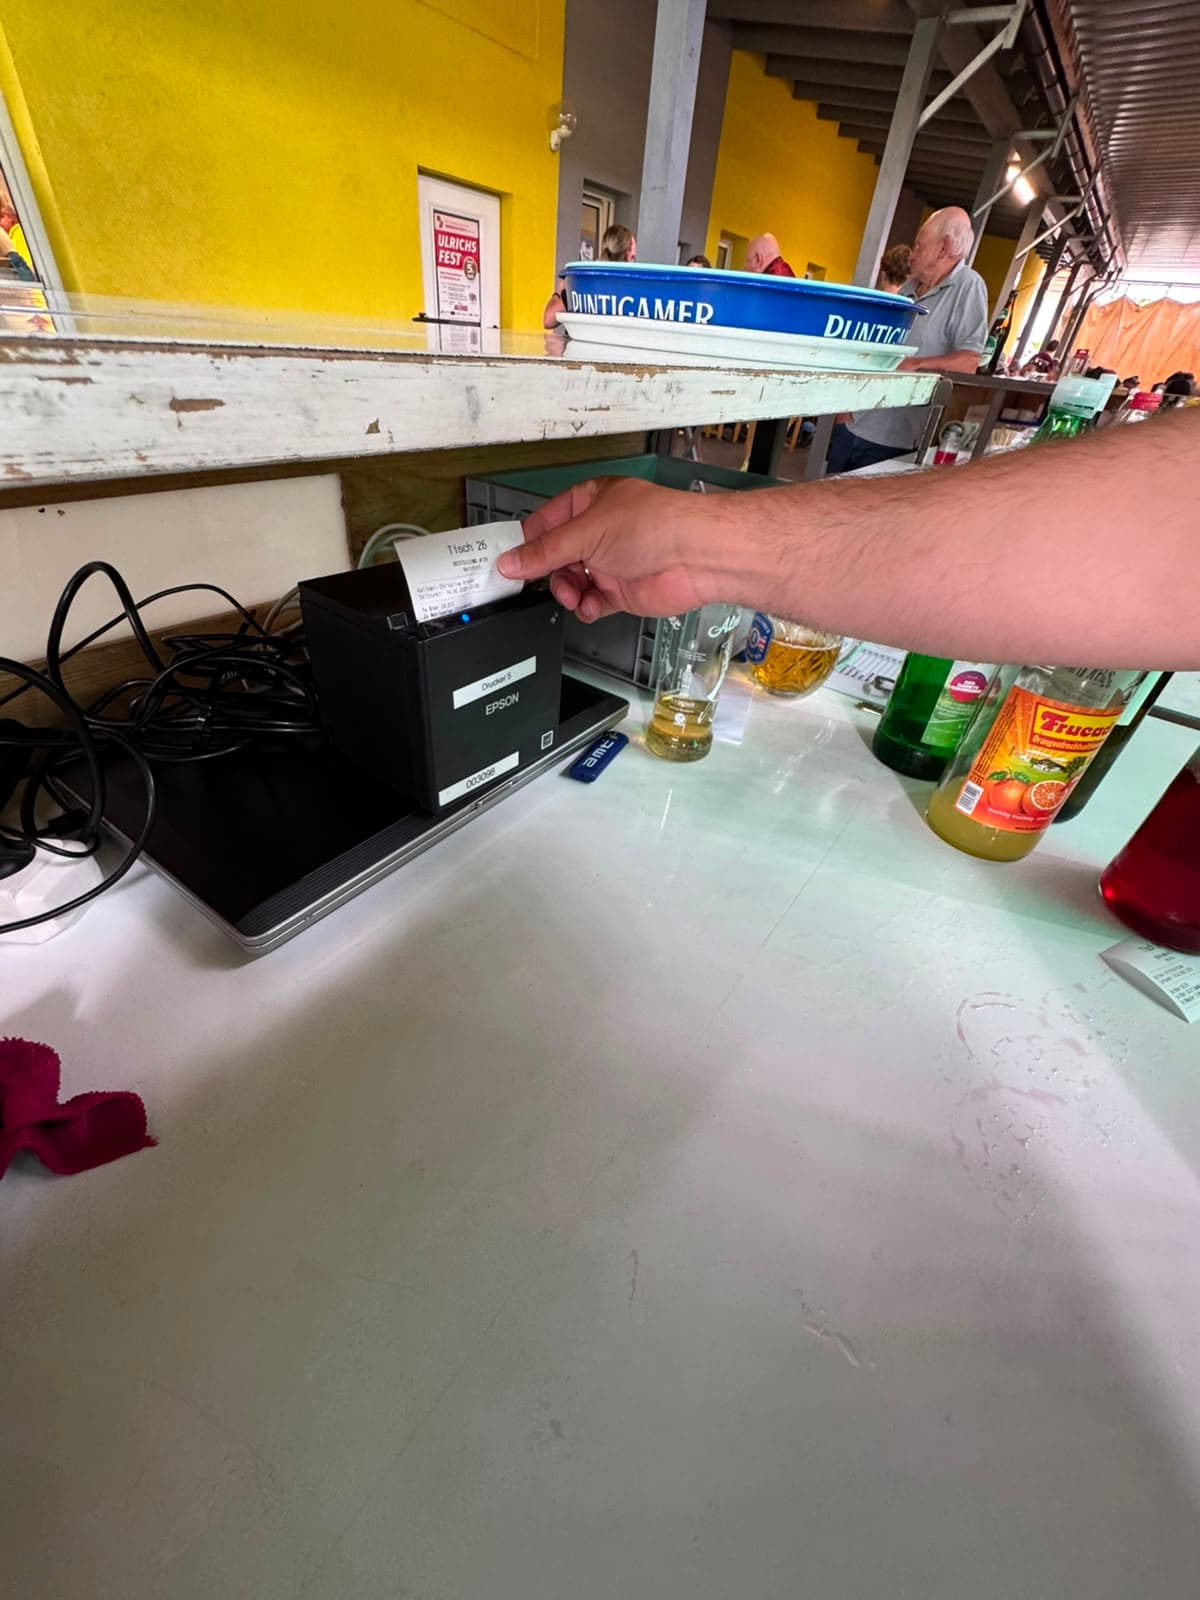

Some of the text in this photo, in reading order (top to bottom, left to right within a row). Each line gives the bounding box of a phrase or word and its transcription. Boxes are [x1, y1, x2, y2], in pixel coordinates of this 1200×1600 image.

[438, 233, 477, 253] ULRICHS
[439, 249, 462, 266] FEST
[571, 290, 714, 325] PUNTIGAMER
[447, 539, 488, 555] Tisch 26
[481, 671, 512, 691] Drucker 5
[485, 692, 520, 717] EPSON
[465, 767, 496, 789] 003098
